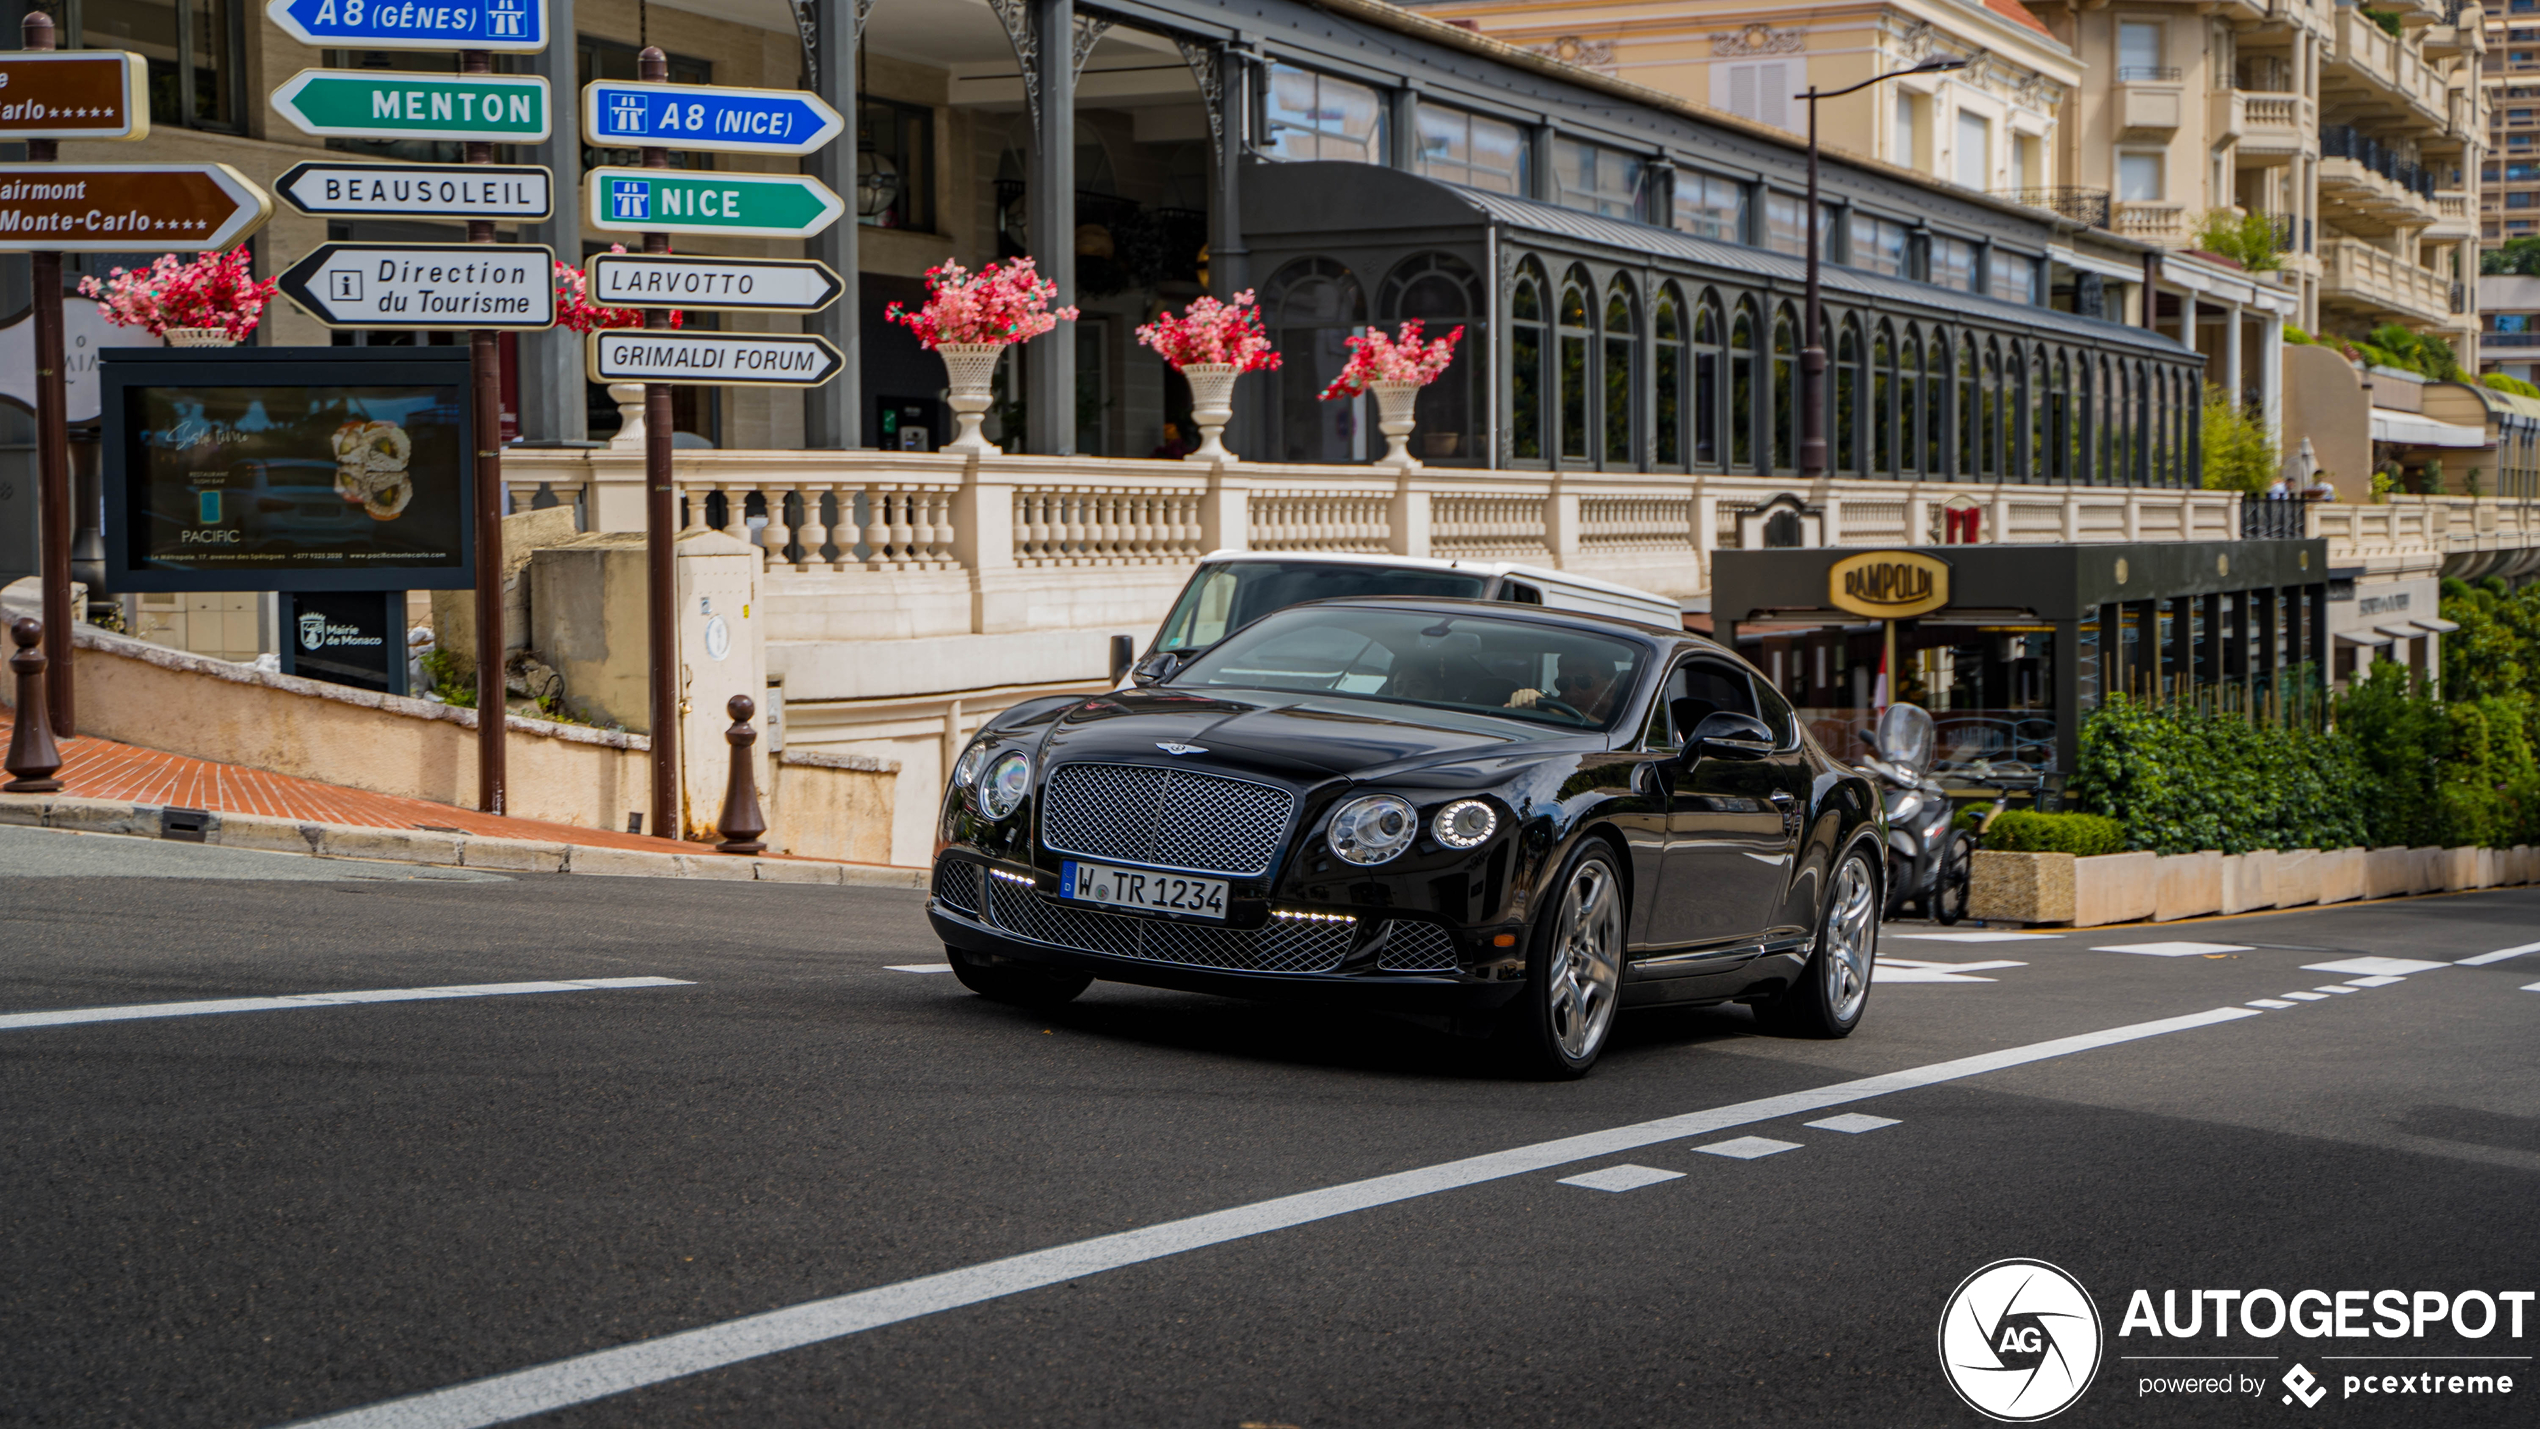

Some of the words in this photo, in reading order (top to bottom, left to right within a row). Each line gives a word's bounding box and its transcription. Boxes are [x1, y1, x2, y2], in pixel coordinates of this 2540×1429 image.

[313, 0, 365, 26] A8
[372, 1, 477, 32] (GÊNES)
[0, 99, 46, 120] arlo
[372, 90, 531, 123] MENTON
[658, 102, 706, 131] A8
[715, 108, 793, 138] (NICE)
[0, 179, 87, 200] airmont
[326, 179, 531, 205] BEAUSOLEIL
[661, 187, 741, 218] NICE
[0, 209, 151, 232] Monte-Carlo
[377, 260, 526, 284] Direction
[611, 270, 754, 295] LARVOTTO
[378, 290, 408, 313] du
[417, 290, 530, 314] Tourisme
[613, 345, 725, 369] GRIMALDI
[733, 349, 815, 372] FORUM
[181, 529, 240, 543] PACIFIC
[1844, 562, 1933, 600] RAMPOLDI
[325, 635, 340, 646] de
[341, 635, 383, 646] Monaco
[326, 624, 360, 635] Mairie
[1078, 866, 1095, 897] W
[1113, 871, 1146, 904] TR
[1152, 877, 1224, 914] 1234
